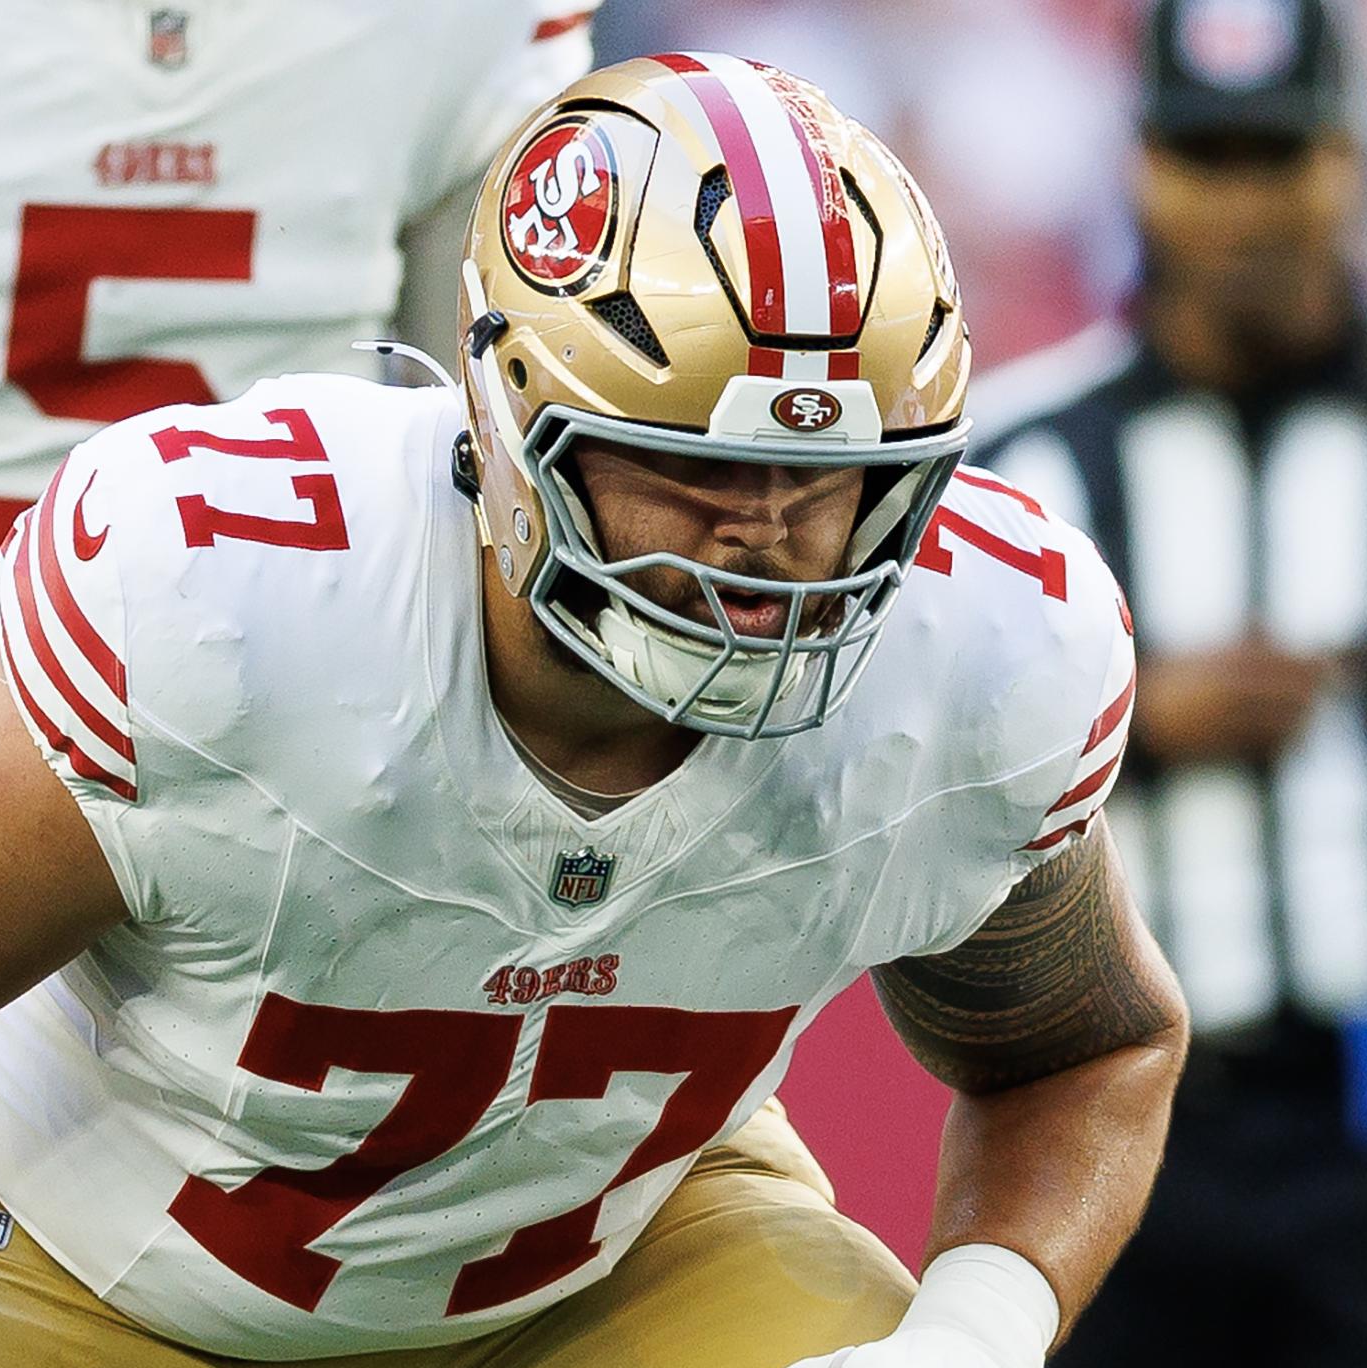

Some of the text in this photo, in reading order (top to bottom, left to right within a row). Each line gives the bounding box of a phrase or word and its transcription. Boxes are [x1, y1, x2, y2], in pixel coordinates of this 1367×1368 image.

[791, 393, 832, 427] SF
[150, 407, 351, 552] 77
[559, 875, 599, 901] NFL
[483, 953, 620, 1005] 49ERS
[166, 992, 801, 1318] 77
